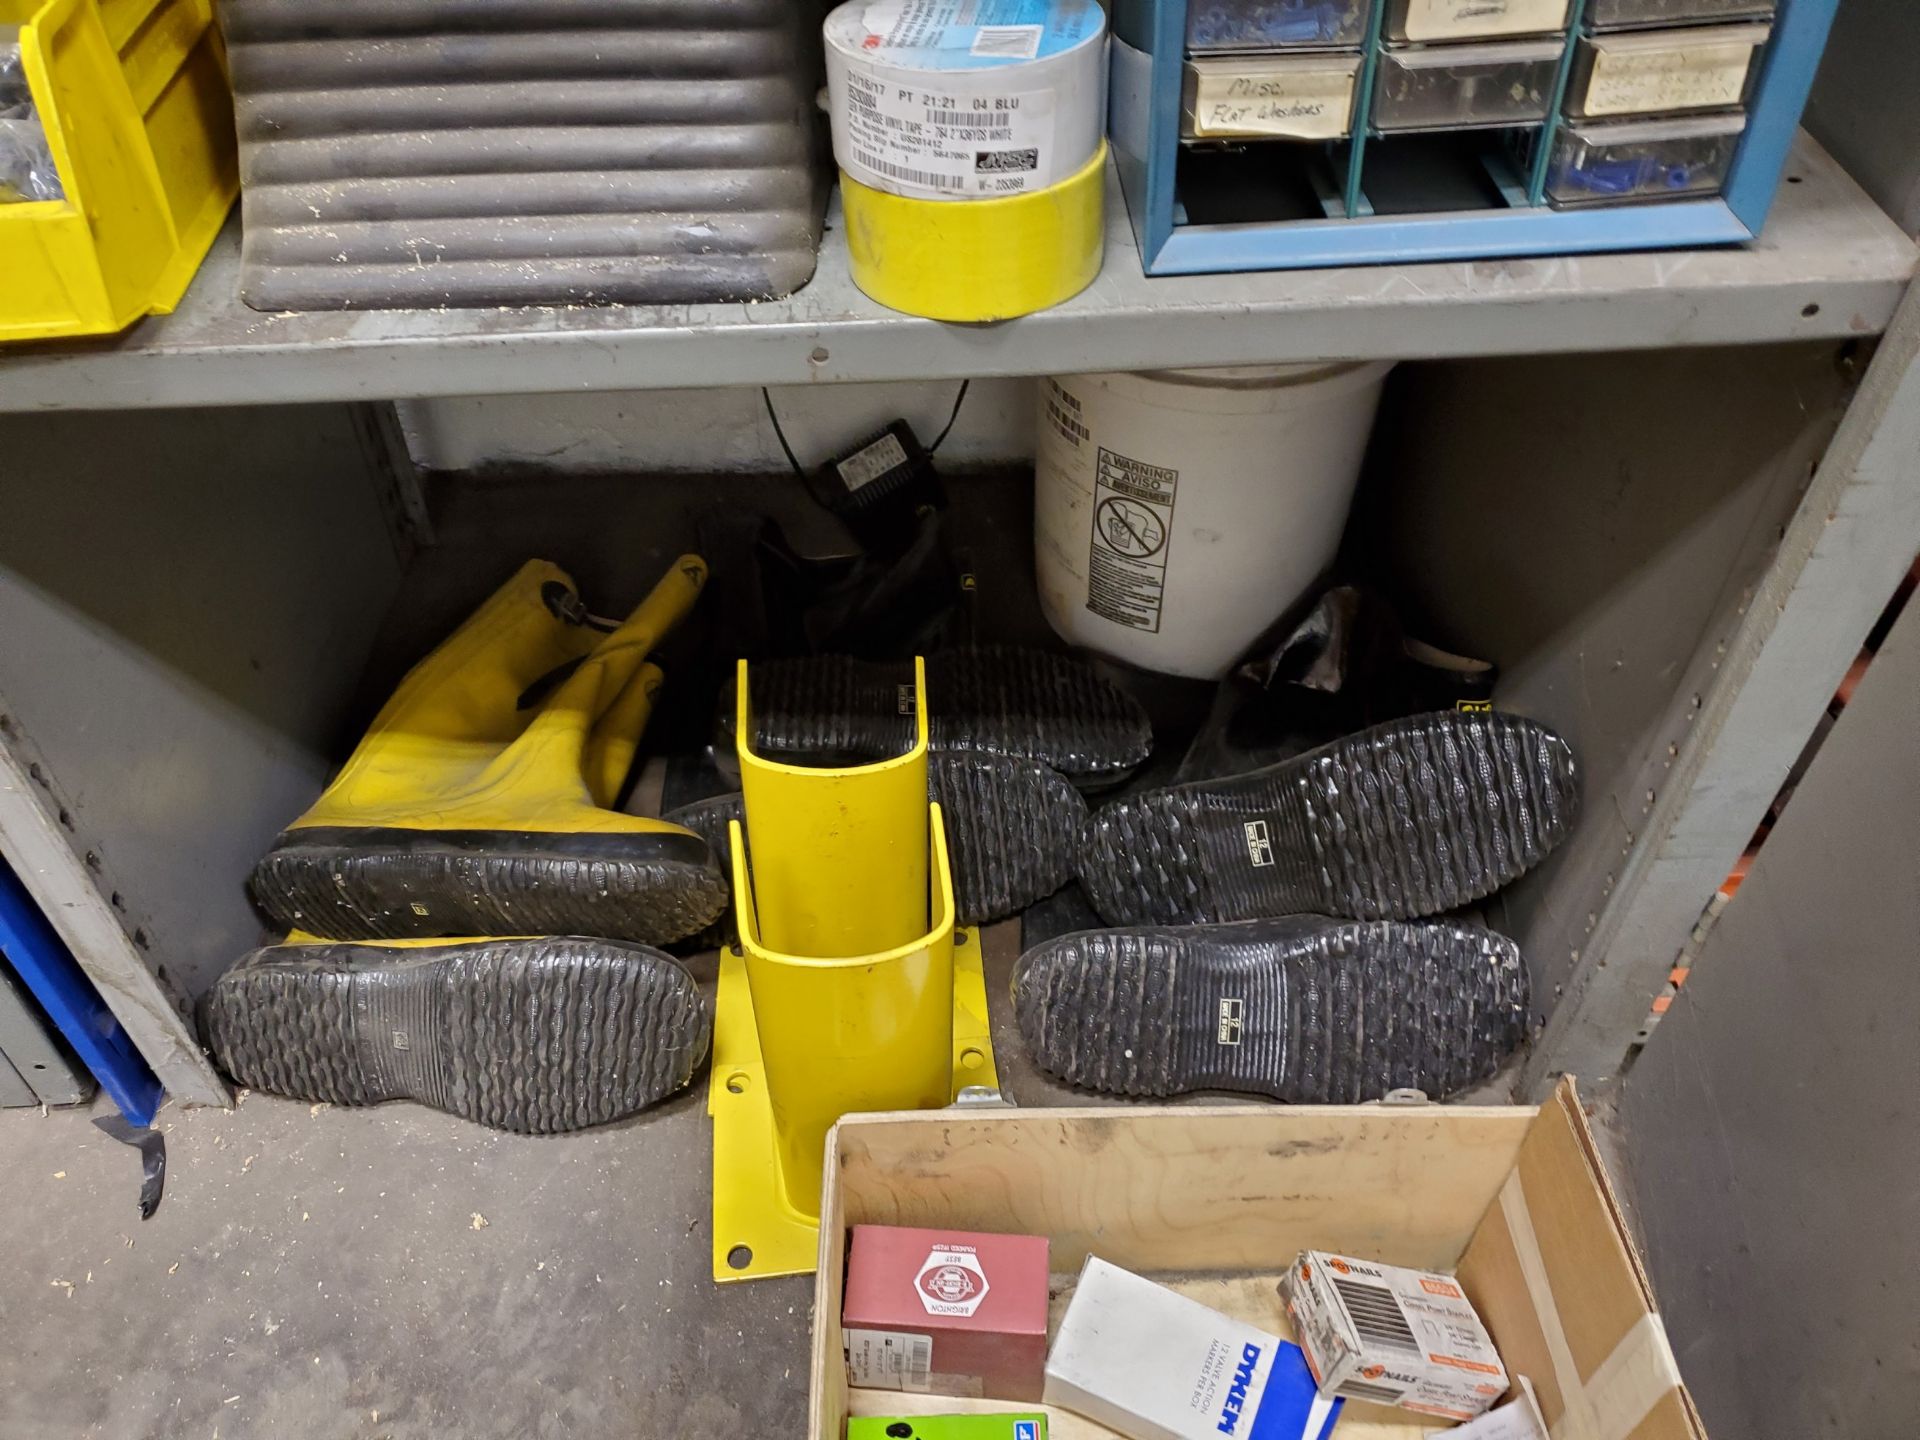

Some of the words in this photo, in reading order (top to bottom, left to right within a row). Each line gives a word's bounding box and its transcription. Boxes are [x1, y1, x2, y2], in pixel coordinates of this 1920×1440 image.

[899, 90, 914, 103] PT
[923, 94, 956, 108] 21:21
[995, 97, 1019, 110] BLU
[1114, 456, 1174, 481] WARNING
[1122, 472, 1161, 490] AVISO
[931, 1304, 969, 1315] BRIGHTON
[1202, 1338, 1219, 1375] MARKERS
[1220, 1343, 1231, 1354] 12
[1212, 1356, 1226, 1380] VALVE
[1191, 1390, 1202, 1408] BOX
[1200, 1380, 1216, 1415] ACTION
[1217, 1342, 1261, 1436] DYKEM
